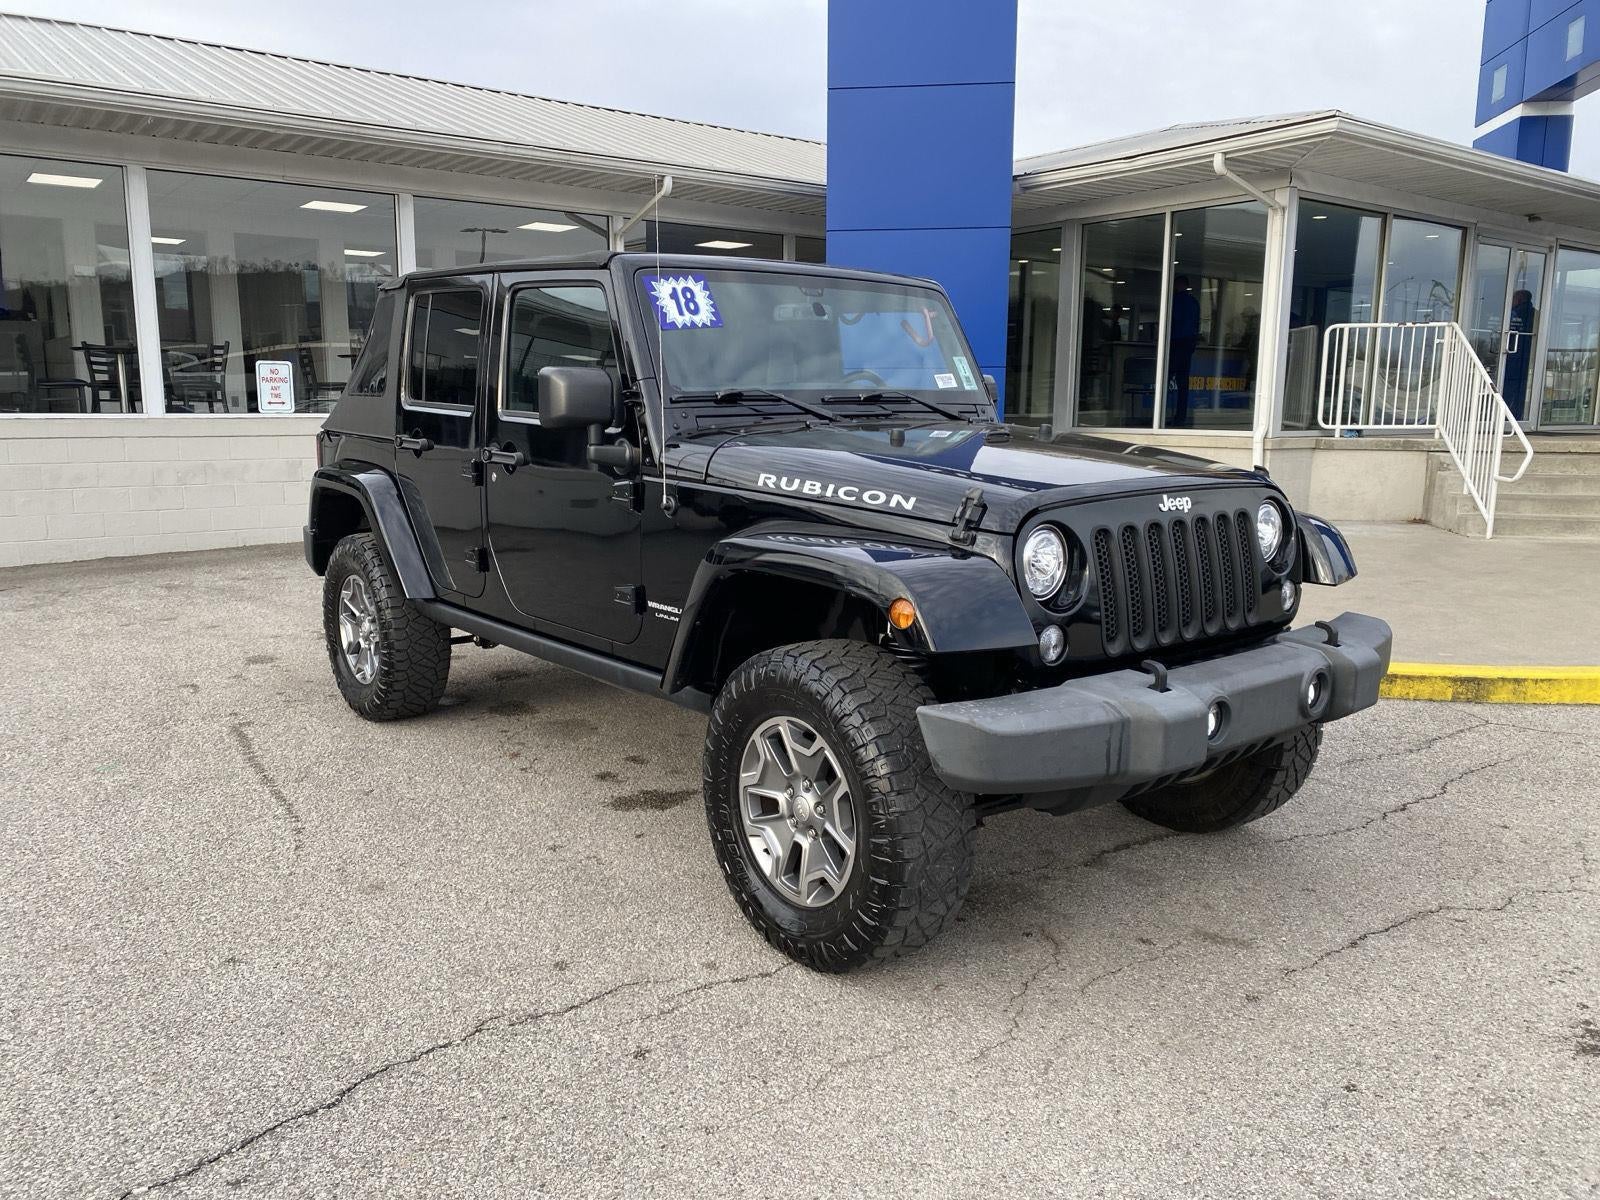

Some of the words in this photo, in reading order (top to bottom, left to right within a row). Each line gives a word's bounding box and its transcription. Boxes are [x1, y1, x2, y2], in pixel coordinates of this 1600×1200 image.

[669, 286, 700, 316] 18
[261, 376, 289, 384] PARKING
[757, 473, 917, 511] RUBICON
[1158, 494, 1192, 513] Jeep
[655, 612, 680, 621] UNLIM
